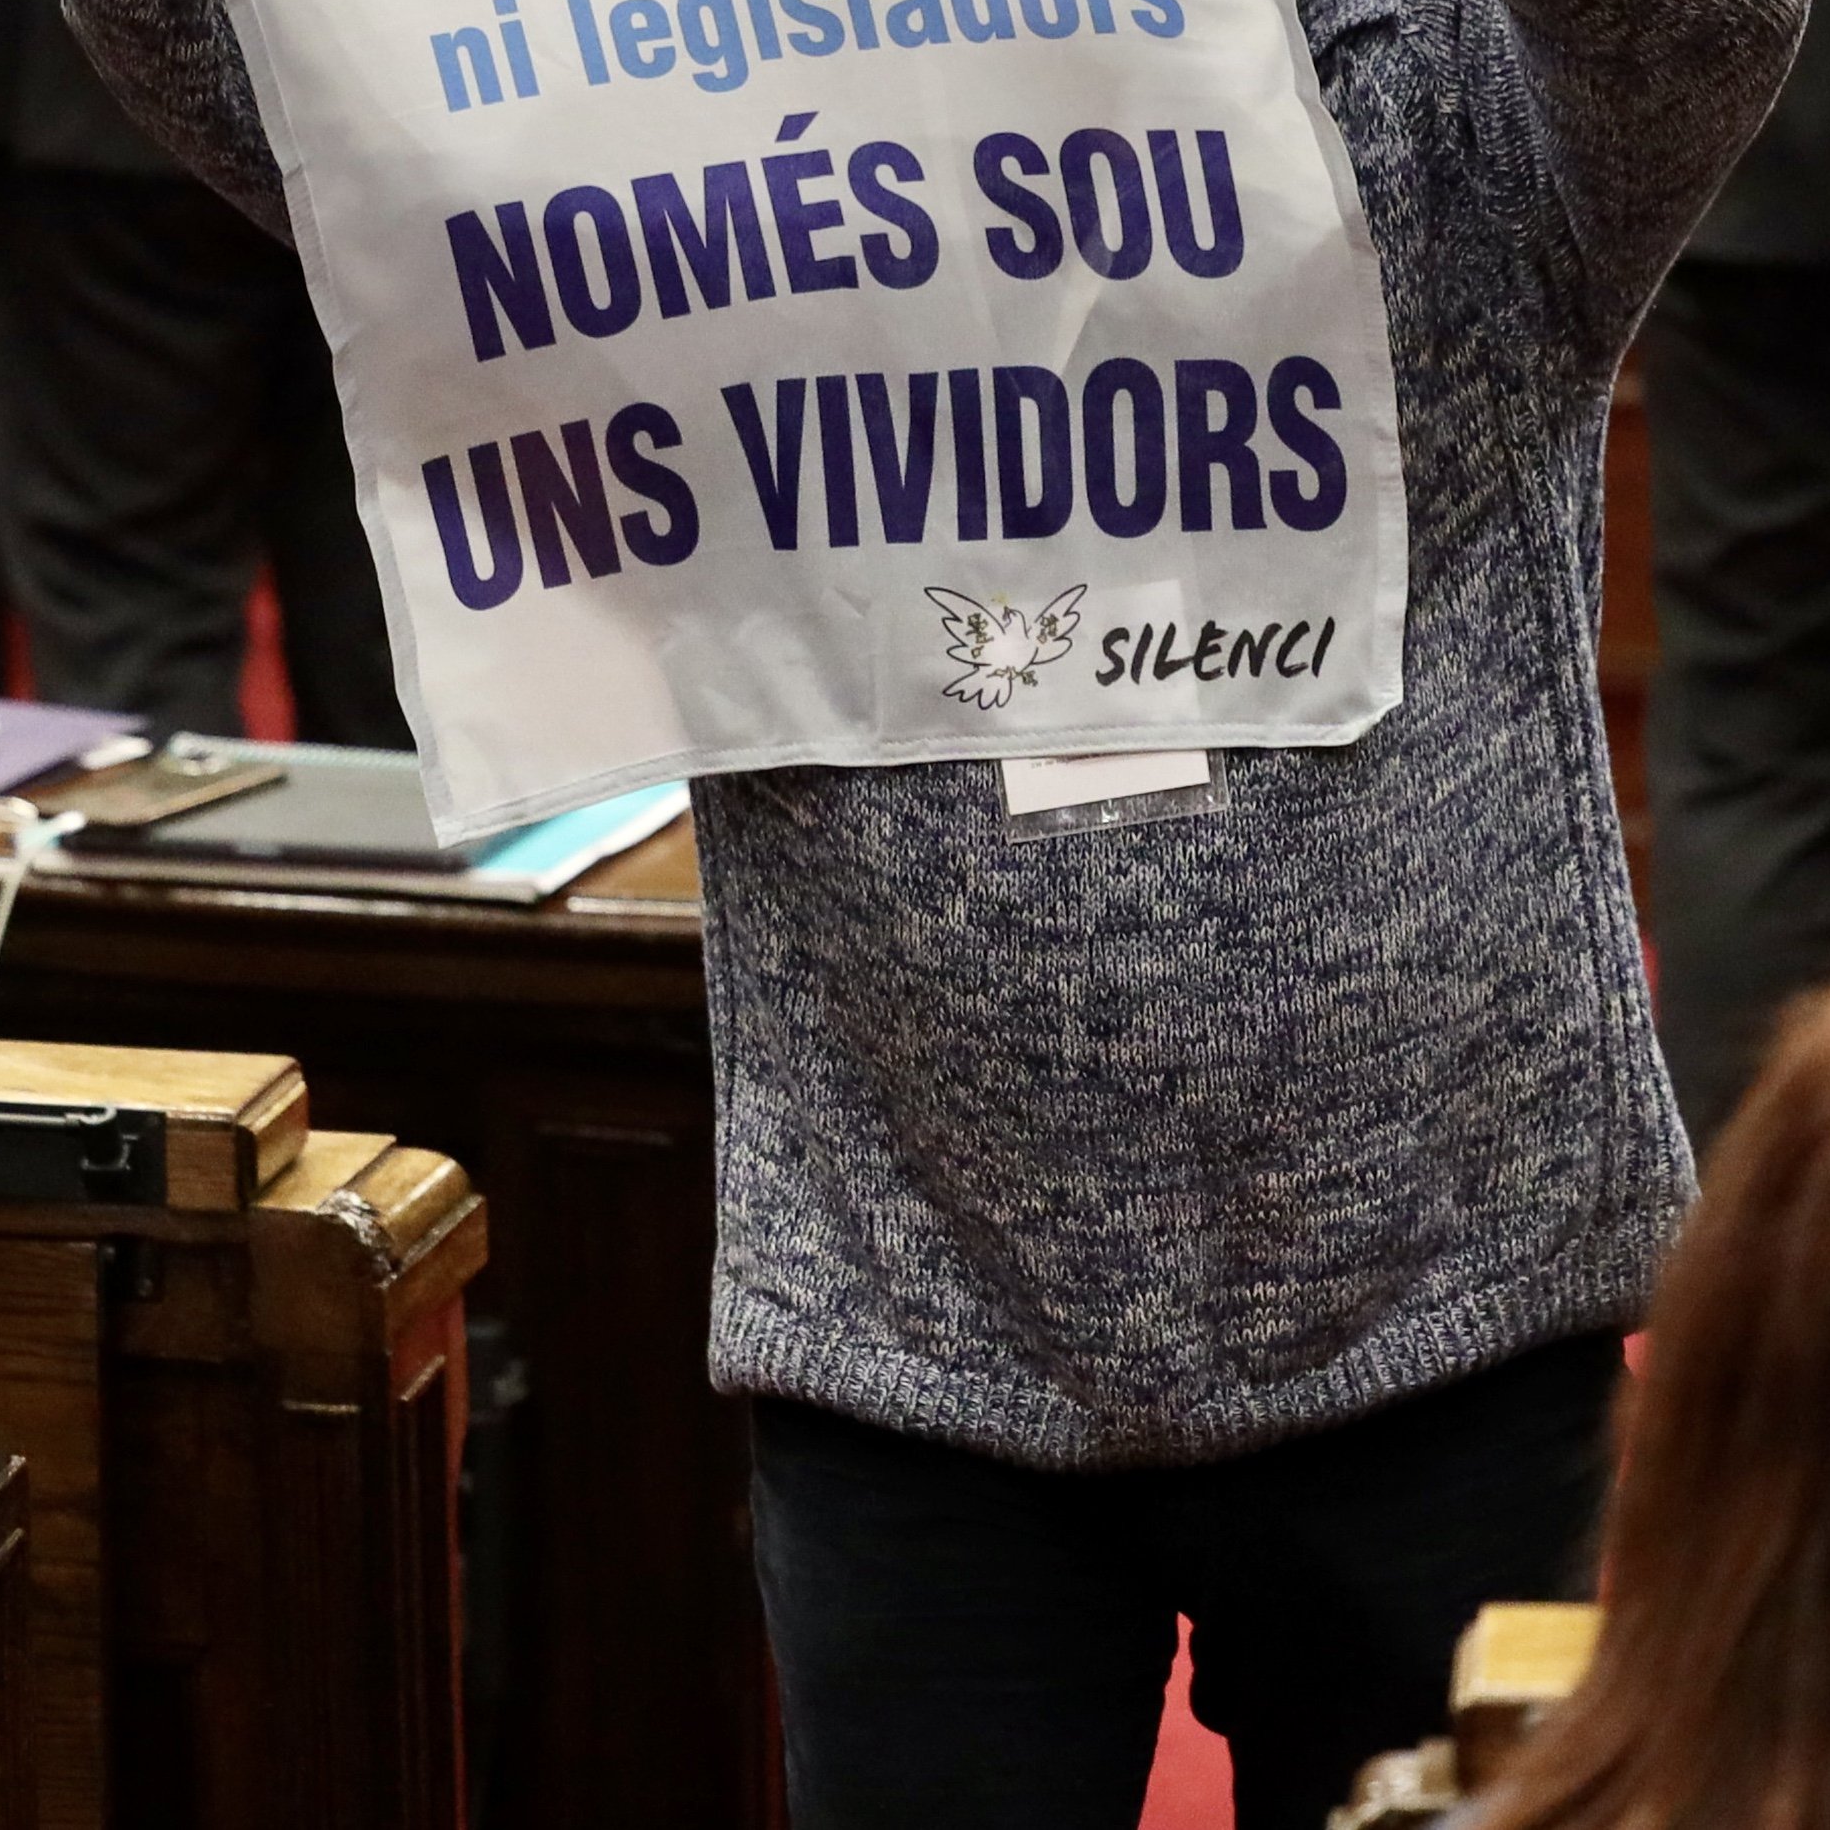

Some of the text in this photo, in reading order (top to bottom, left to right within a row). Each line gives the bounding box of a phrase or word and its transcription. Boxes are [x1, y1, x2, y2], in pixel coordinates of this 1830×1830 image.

[445, 112, 1244, 363] NOMÉS SOU
[421, 355, 1347, 610] UNS VIVIDORS
[1096, 617, 1335, 685] SILENCI
